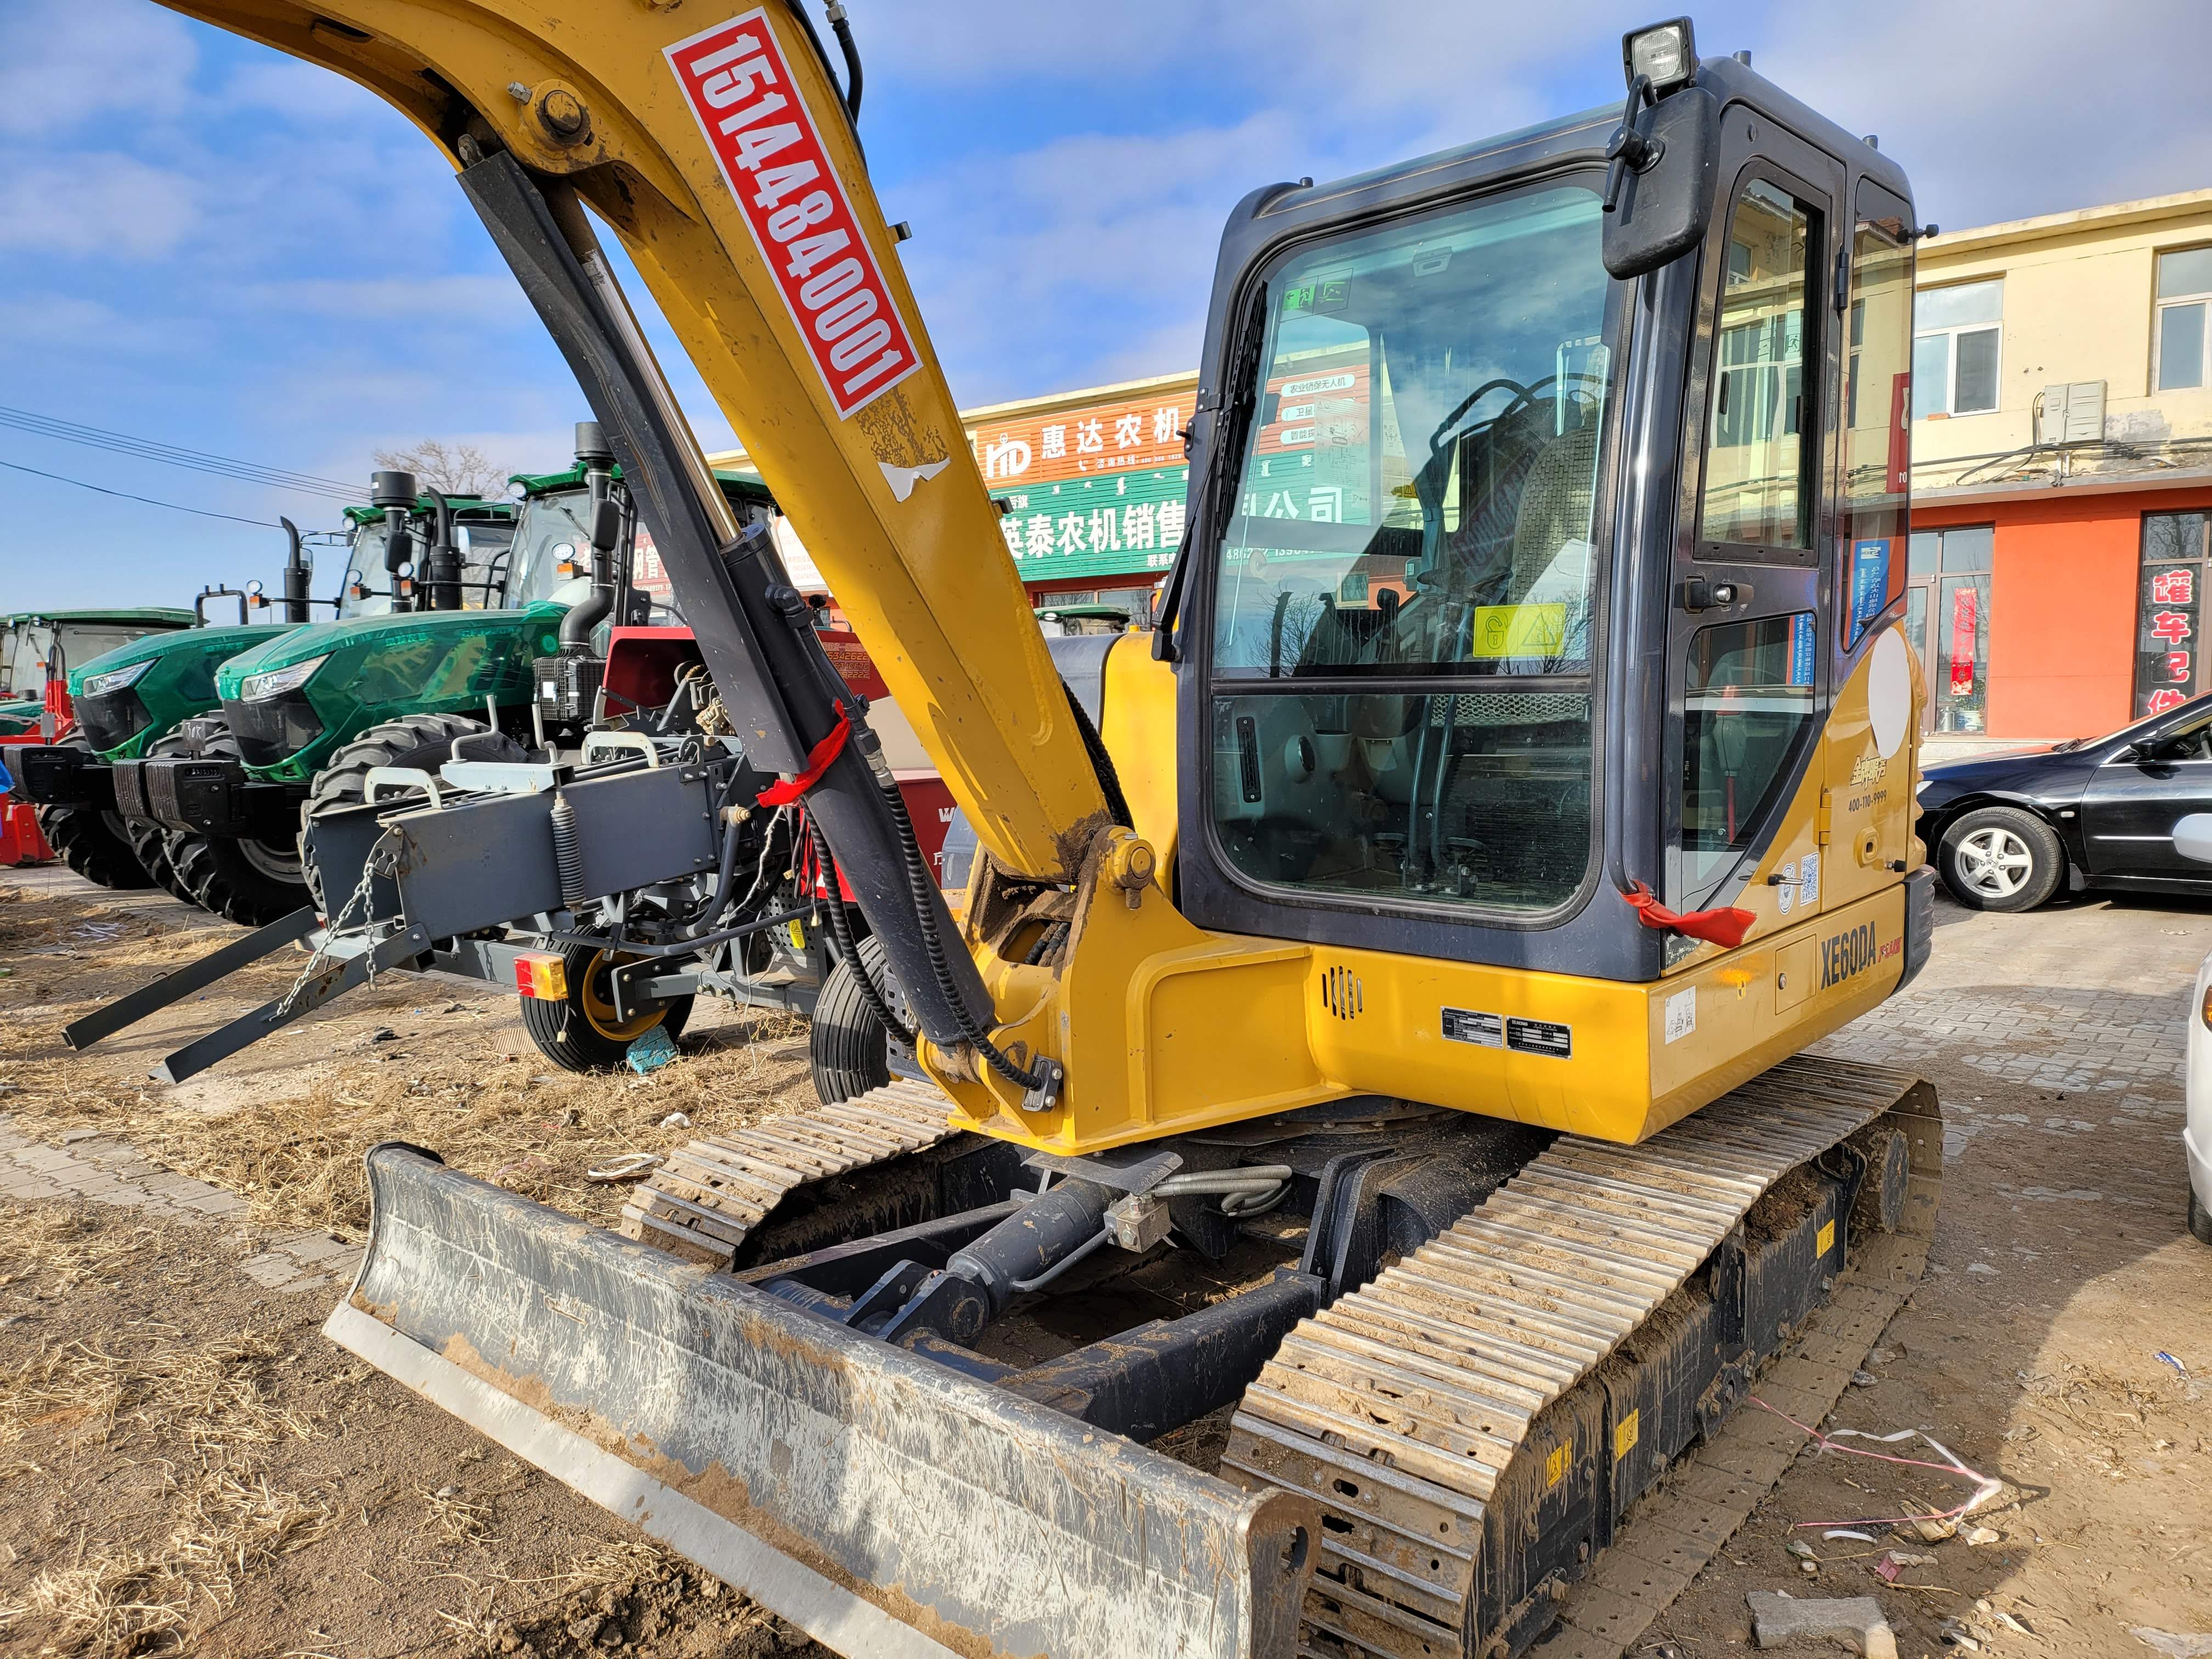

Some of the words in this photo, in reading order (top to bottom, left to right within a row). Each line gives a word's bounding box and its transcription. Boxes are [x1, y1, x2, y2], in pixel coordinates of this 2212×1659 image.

[690, 33, 904, 395] 15144840001
[1042, 407, 1181, 460] 惠达农机
[1848, 789, 1887, 813] 400-110-9999
[1820, 920, 1877, 991] XE60DA
